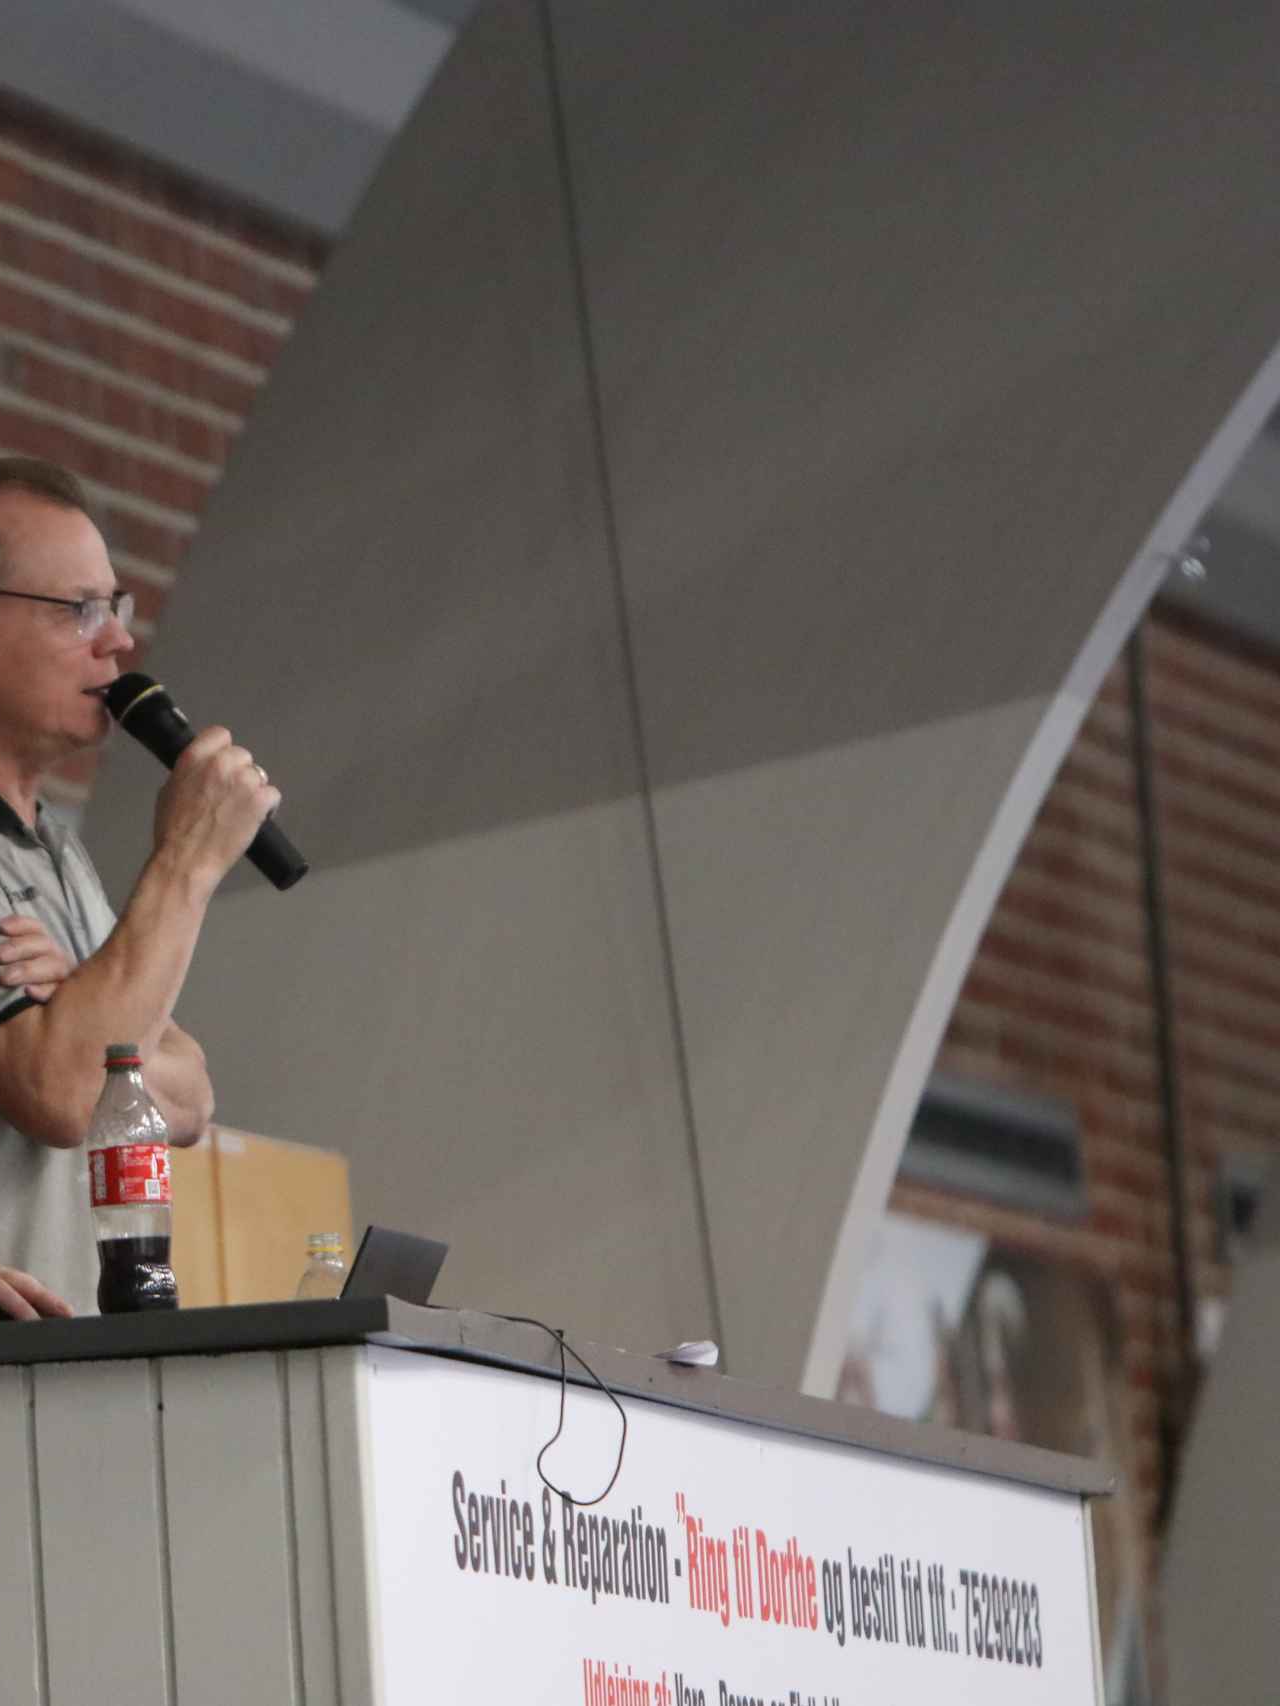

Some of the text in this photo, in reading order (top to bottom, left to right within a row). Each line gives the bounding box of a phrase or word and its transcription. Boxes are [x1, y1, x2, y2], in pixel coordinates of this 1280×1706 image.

[452, 1469, 536, 1582] Service
[542, 1485, 558, 1585] &
[561, 1490, 671, 1606] Reparation
[733, 1525, 754, 1619] til
[756, 1528, 819, 1632] Dorthe
[822, 1558, 846, 1648] og
[847, 1546, 900, 1644] bestil
[901, 1557, 927, 1649] tid
[959, 1567, 1043, 1669] 75298283
